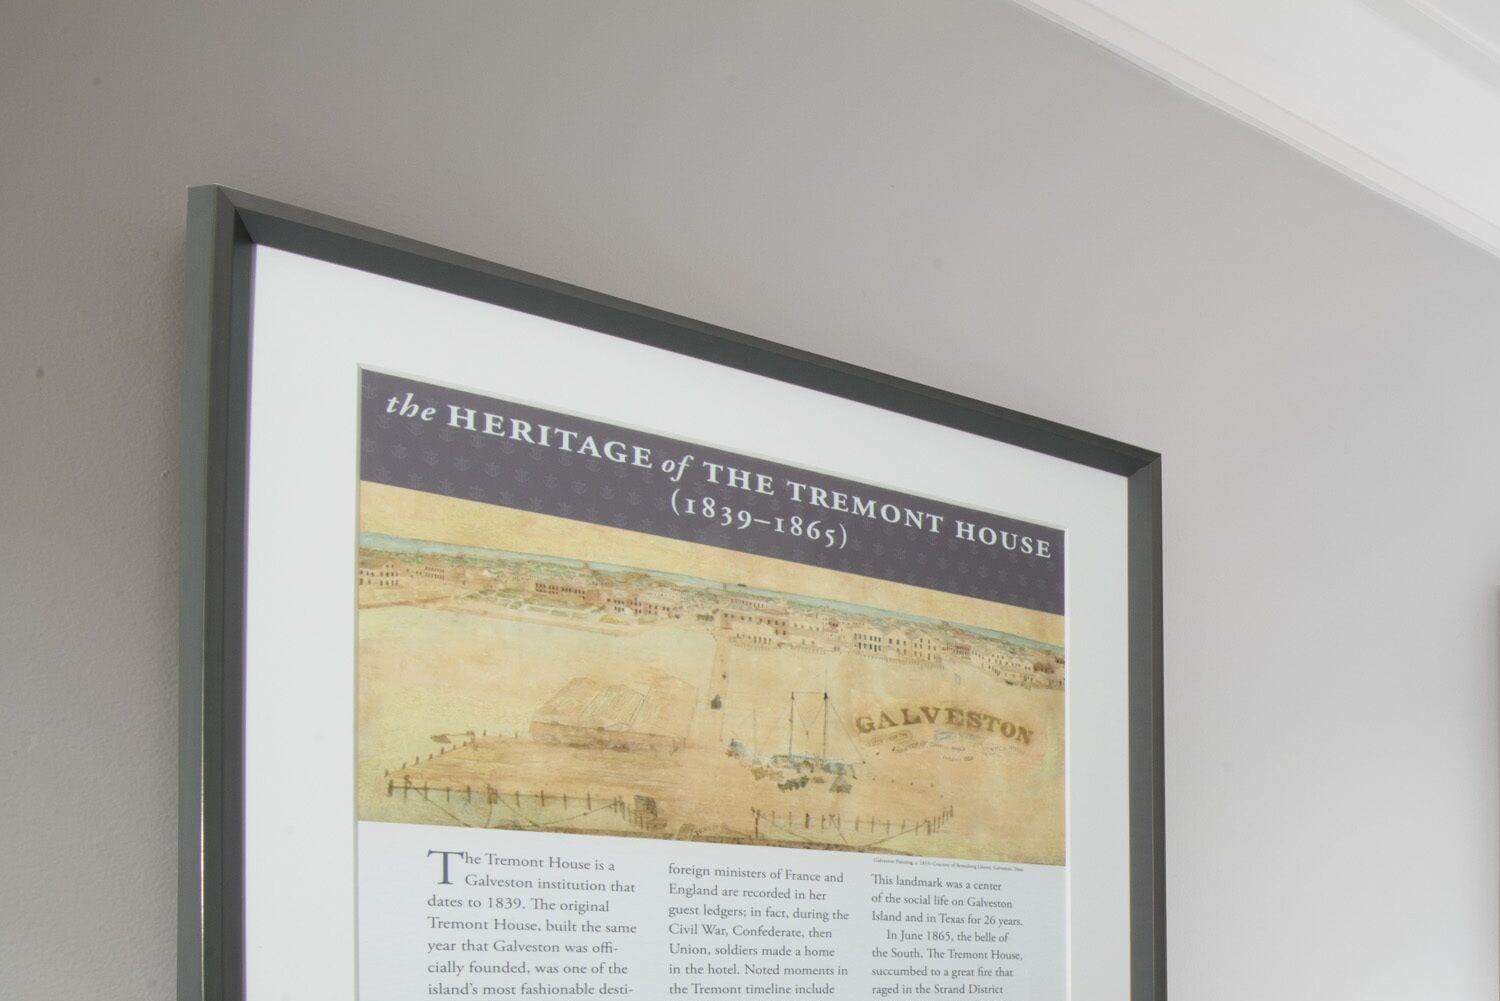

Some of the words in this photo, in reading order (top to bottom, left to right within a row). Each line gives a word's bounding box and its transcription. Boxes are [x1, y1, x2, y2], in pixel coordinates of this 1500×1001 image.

[386, 391, 437, 423] the
[447, 404, 653, 470] HERITAGE
[661, 454, 693, 481] of
[702, 460, 776, 497] THE
[786, 480, 944, 534] TREMONT
[955, 521, 1051, 560] HOUSE
[855, 706, 1035, 745] GALVESTON
[484, 853, 544, 868] Tremont
[548, 856, 592, 870] House
[595, 860, 605, 871] is
[608, 864, 615, 872] a
[668, 862, 711, 879] foreign
[714, 867, 767, 879] ministers
[769, 868, 783, 880] of
[785, 869, 821, 882] France
[824, 872, 844, 883] and
[465, 873, 533, 889] Galveston
[538, 878, 606, 892] institution
[610, 880, 635, 893] that
[871, 873, 894, 885] This
[895, 874, 944, 888] landmark
[946, 881, 964, 889] was
[965, 882, 972, 890] a
[973, 883, 1002, 891] center
[669, 883, 718, 899] England
[721, 889, 739, 897] are
[743, 887, 791, 900] recorded
[794, 889, 806, 900] in
[809, 889, 827, 901] her
[871, 892, 884, 903] of
[885, 892, 901, 904] the
[904, 894, 931, 905] social
[934, 894, 949, 906] life
[951, 899, 964, 907] on
[966, 896, 1013, 909] Galveston
[427, 893, 463, 908] dates
[468, 899, 482, 908] to
[489, 897, 526, 910] 1839.
[530, 897, 557, 911] The
[560, 900, 609, 916] original
[668, 907, 699, 918] guest
[703, 904, 747, 920] ledgers;
[750, 906, 762, 917] in
[765, 906, 789, 919] fact,
[792, 907, 830, 923] during
[832, 909, 850, 920] the
[872, 910, 903, 922] Island
[905, 912, 924, 923] and
[926, 913, 937, 923] in
[938, 912, 965, 924] Texas
[967, 913, 982, 925] for
[984, 915, 996, 926] 26
[998, 918, 1023, 929] years.
[427, 916, 489, 930] Tremont
[494, 918, 542, 932] House,
[546, 919, 577, 932] built
[581, 920, 602, 933] the
[605, 925, 637, 934] same
[668, 923, 698, 935] Civil
[701, 924, 729, 937] War,
[732, 924, 805, 939] Confederate,
[808, 926, 832, 938] then
[887, 929, 898, 940] In
[900, 929, 924, 943] June
[927, 930, 954, 942] 1865,
[957, 931, 972, 942] the
[974, 931, 997, 943] belle
[998, 932, 1010, 943] of
[427, 943, 457, 954] year
[461, 938, 489, 952] that
[493, 939, 560, 953] Galveston
[565, 945, 588, 953] was
[592, 941, 619, 954] offi-
[669, 943, 711, 956] Union,
[715, 944, 758, 956] soldiers
[761, 945, 792, 957] made
[795, 949, 802, 957] a
[804, 945, 836, 957] home
[872, 946, 889, 958] the
[891, 947, 924, 959] South,
[926, 947, 946, 959] The
[946, 948, 988, 960] Tremont
[991, 949, 1023, 961] House,
[428, 960, 465, 977] cially
[470, 960, 531, 975] founded,
[534, 966, 559, 974] was
[563, 966, 587, 974] one
[590, 962, 606, 974] of
[608, 962, 628, 974] the
[669, 964, 681, 975] in
[685, 962, 704, 975] the
[708, 963, 740, 975] hotel.
[744, 963, 780, 976] Noted
[784, 968, 835, 976] moments
[838, 965, 848, 976] in
[872, 965, 928, 977] succumbed
[931, 969, 941, 977] to
[944, 969, 949, 977] a
[951, 969, 975, 980] great
[977, 966, 993, 977] fire
[995, 966, 1014, 977] that
[429, 982, 479, 995] island’s
[483, 987, 516, 995] most
[521, 982, 595, 995] fashionable
[599, 982, 634, 995] desti-
[669, 982, 689, 995] the
[691, 983, 742, 995] Tremont
[745, 983, 792, 995] timeline
[795, 983, 835, 995] include
[872, 983, 900, 998] raged
[902, 984, 912, 994] in
[915, 983, 931, 994] the
[934, 984, 966, 994] Strand
[968, 984, 1004, 994] District
